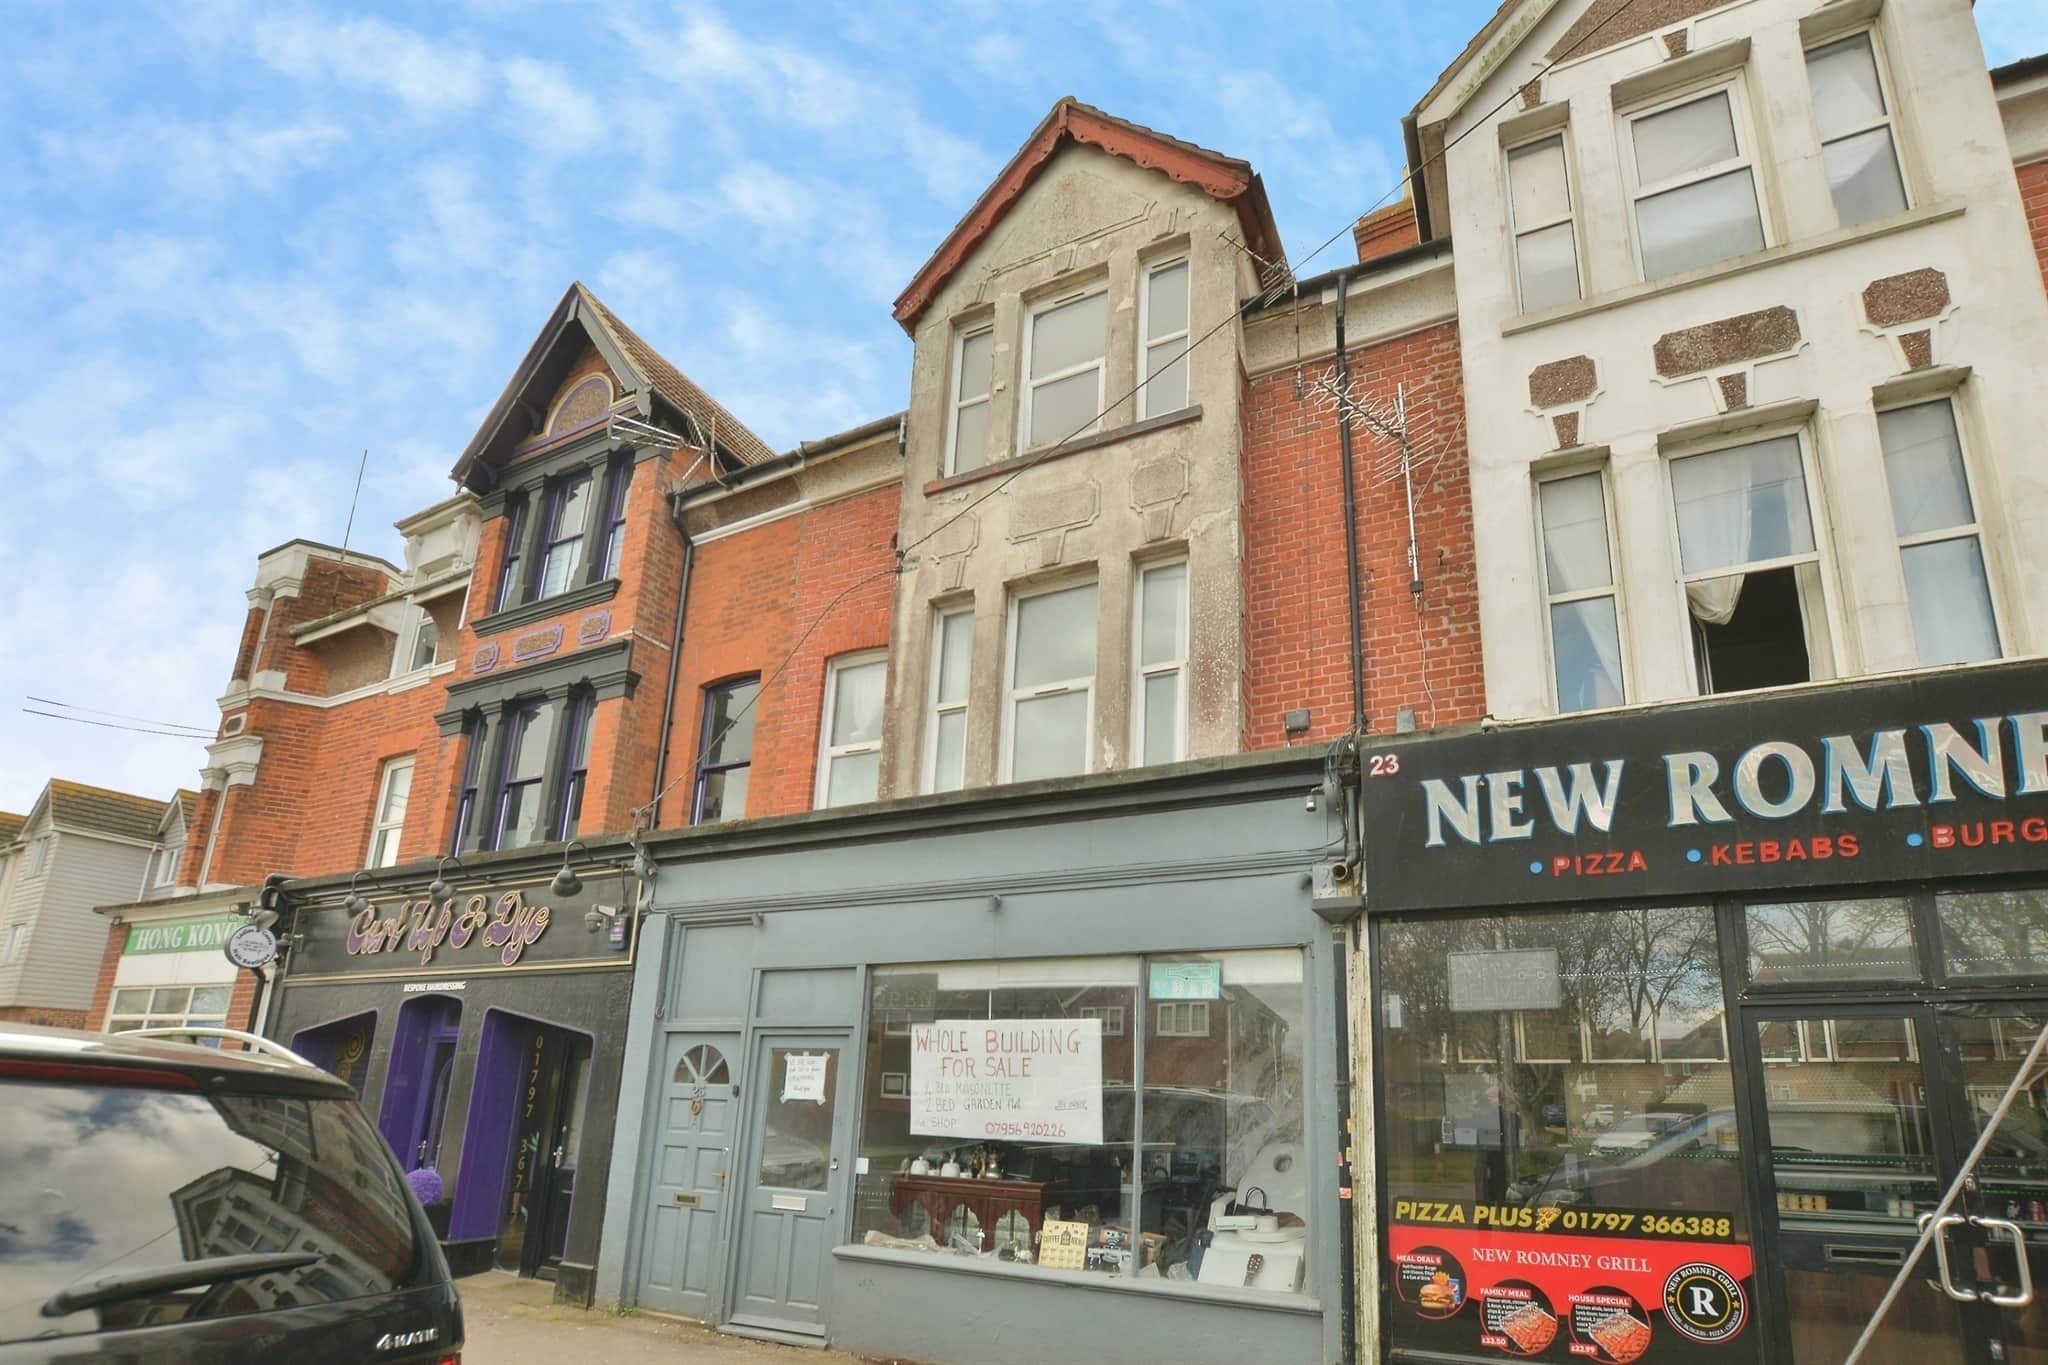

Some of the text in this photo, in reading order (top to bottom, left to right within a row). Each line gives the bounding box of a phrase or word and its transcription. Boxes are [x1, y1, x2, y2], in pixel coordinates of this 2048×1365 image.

[1369, 753, 1400, 777] 23
[1420, 759, 1625, 848] NEW
[1552, 851, 1648, 877] PIZZA
[1711, 833, 1860, 866] KEBABS
[346, 890, 551, 966] Curl Up & Dye
[915, 1029, 1081, 1055] WHOLE BUILDING
[526, 1035, 544, 1118] 01797
[941, 1056, 1032, 1078] FOR SALE
[936, 1098, 955, 1112] BED
[964, 1098, 1002, 1112] GARDEN
[931, 1117, 957, 1129] SHOP
[1395, 1201, 1731, 1237] PIZZA PLUS 01797 366388
[1396, 1254, 1416, 1262] MEAL
[1417, 1256, 1435, 1264] DEAL
[1472, 1248, 1652, 1273] NEW ROMNEY GRILL
[1480, 1288, 1529, 1298] FAMILY MEAL
[1667, 1266, 1738, 1298] NEW ROMNEY GRILL
[1568, 1294, 1629, 1305] HOUSE SPECIAL
[1689, 1286, 1719, 1317] R
